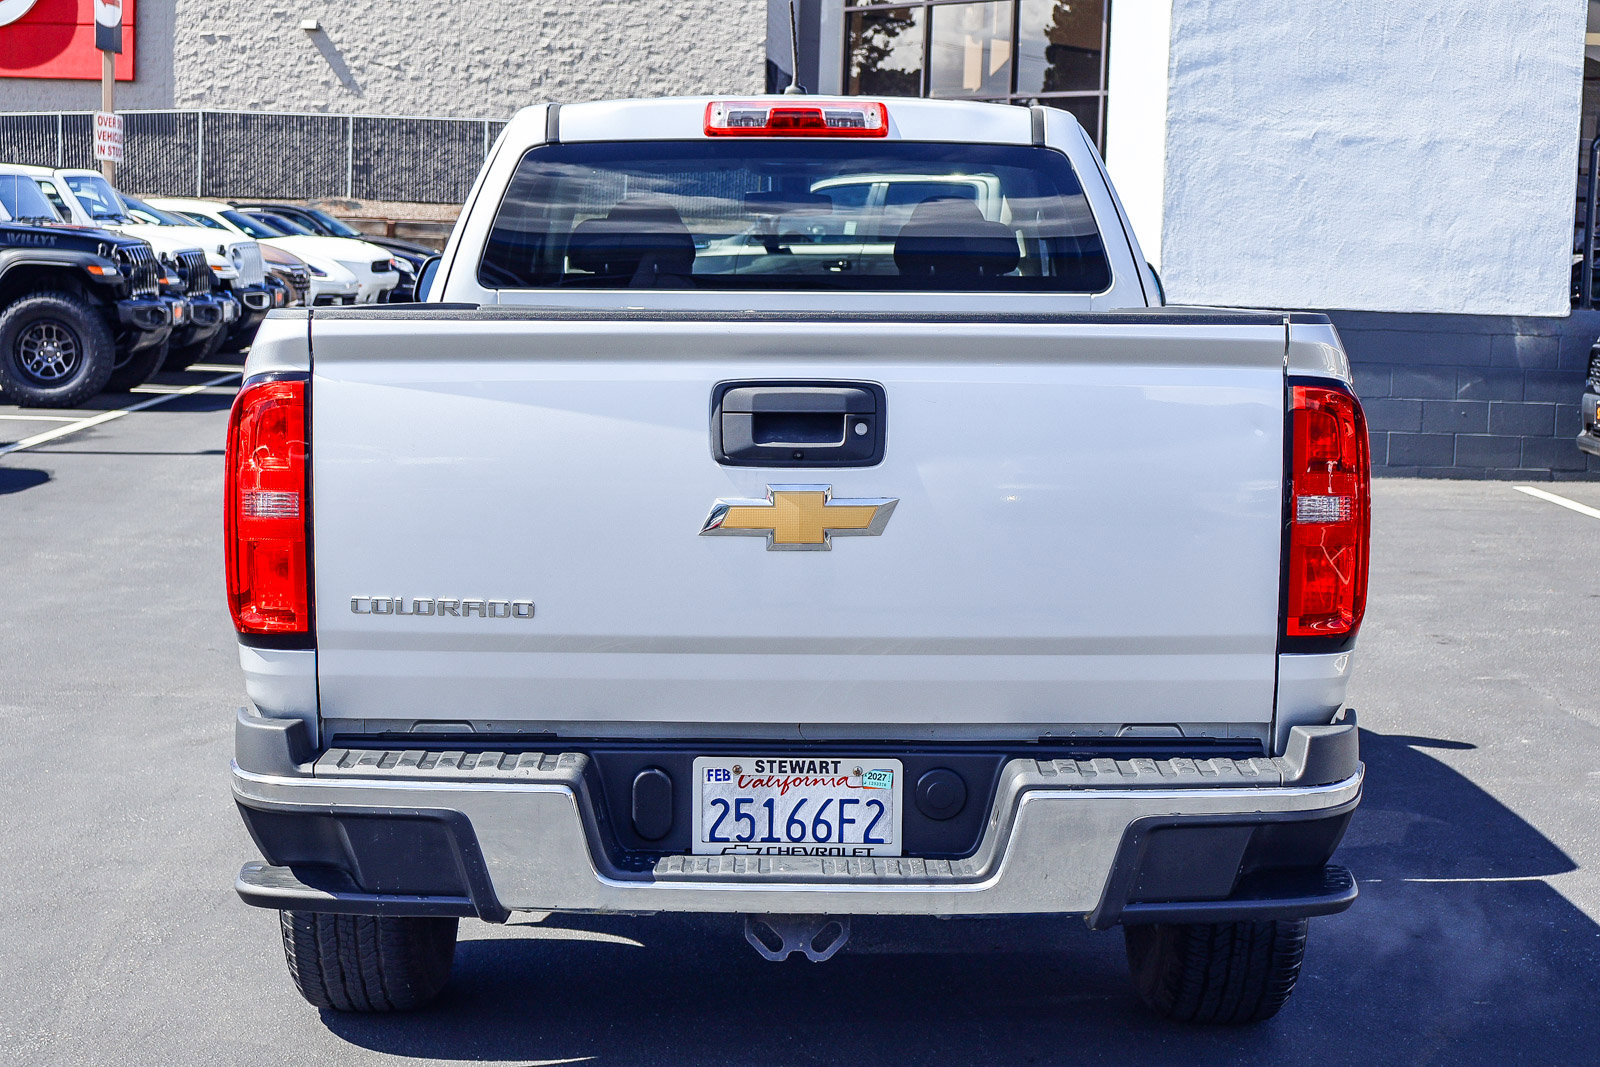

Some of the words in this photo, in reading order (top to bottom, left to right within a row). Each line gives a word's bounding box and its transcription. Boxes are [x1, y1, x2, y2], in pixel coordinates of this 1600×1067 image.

[97, 115, 116, 128] OVER
[97, 144, 106, 156] IN
[7, 232, 57, 247] WILLYS
[350, 595, 536, 619] COLORADO
[754, 759, 842, 775] STEWART
[706, 768, 731, 783] FEB
[867, 772, 888, 782] 2027
[737, 774, 863, 796] California
[709, 798, 884, 843] 25166F2
[766, 847, 875, 857] CHEVROLET
